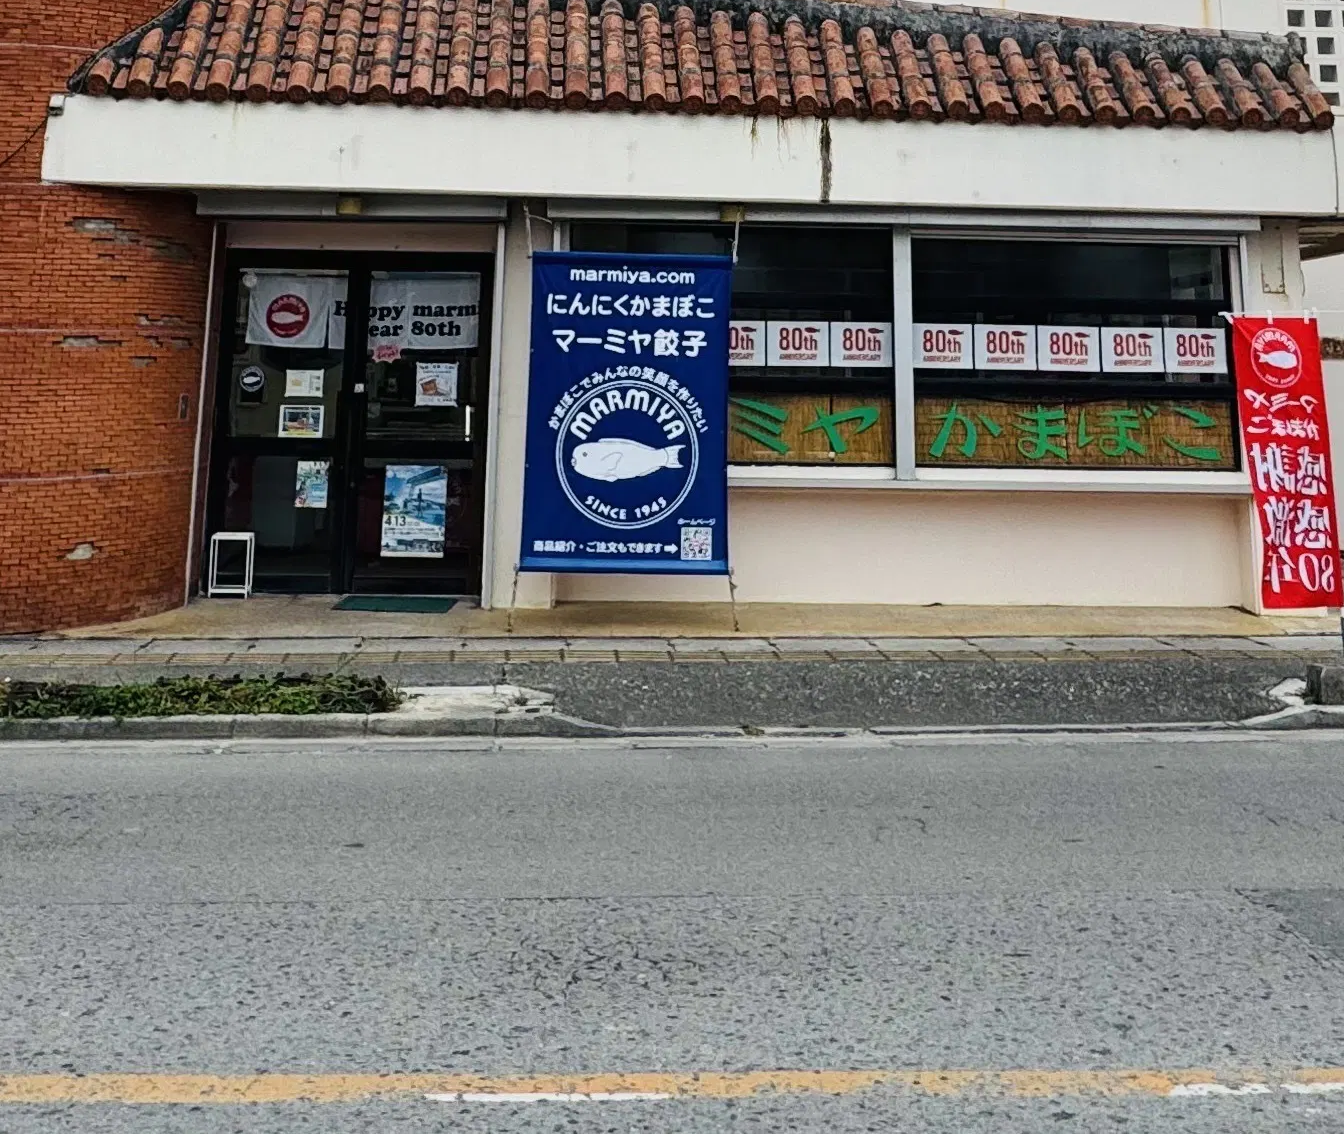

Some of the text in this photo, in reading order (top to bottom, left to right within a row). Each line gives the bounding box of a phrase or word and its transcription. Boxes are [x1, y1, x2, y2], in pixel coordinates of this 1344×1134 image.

[570, 266, 695, 284] marmiya.com
[412, 302, 479, 317] marm
[547, 293, 716, 319] にんにくかまぼこ
[369, 321, 461, 337] ear 80th
[729, 327, 754, 350] 0th
[779, 327, 818, 351] 80th
[842, 328, 881, 351] 80th
[923, 329, 962, 353] 80th
[552, 329, 708, 358] マーミヤ餃子
[986, 330, 1025, 354] 80th
[1050, 332, 1088, 356] 80th
[1113, 333, 1152, 357] 80th
[1176, 334, 1215, 357] 80th
[548, 365, 708, 433] かまぼこでみんなの笑顔を作りたい
[570, 389, 686, 440] MARMIYA
[929, 401, 1222, 462] かまぼこ
[584, 495, 668, 520] SINCE 1945
